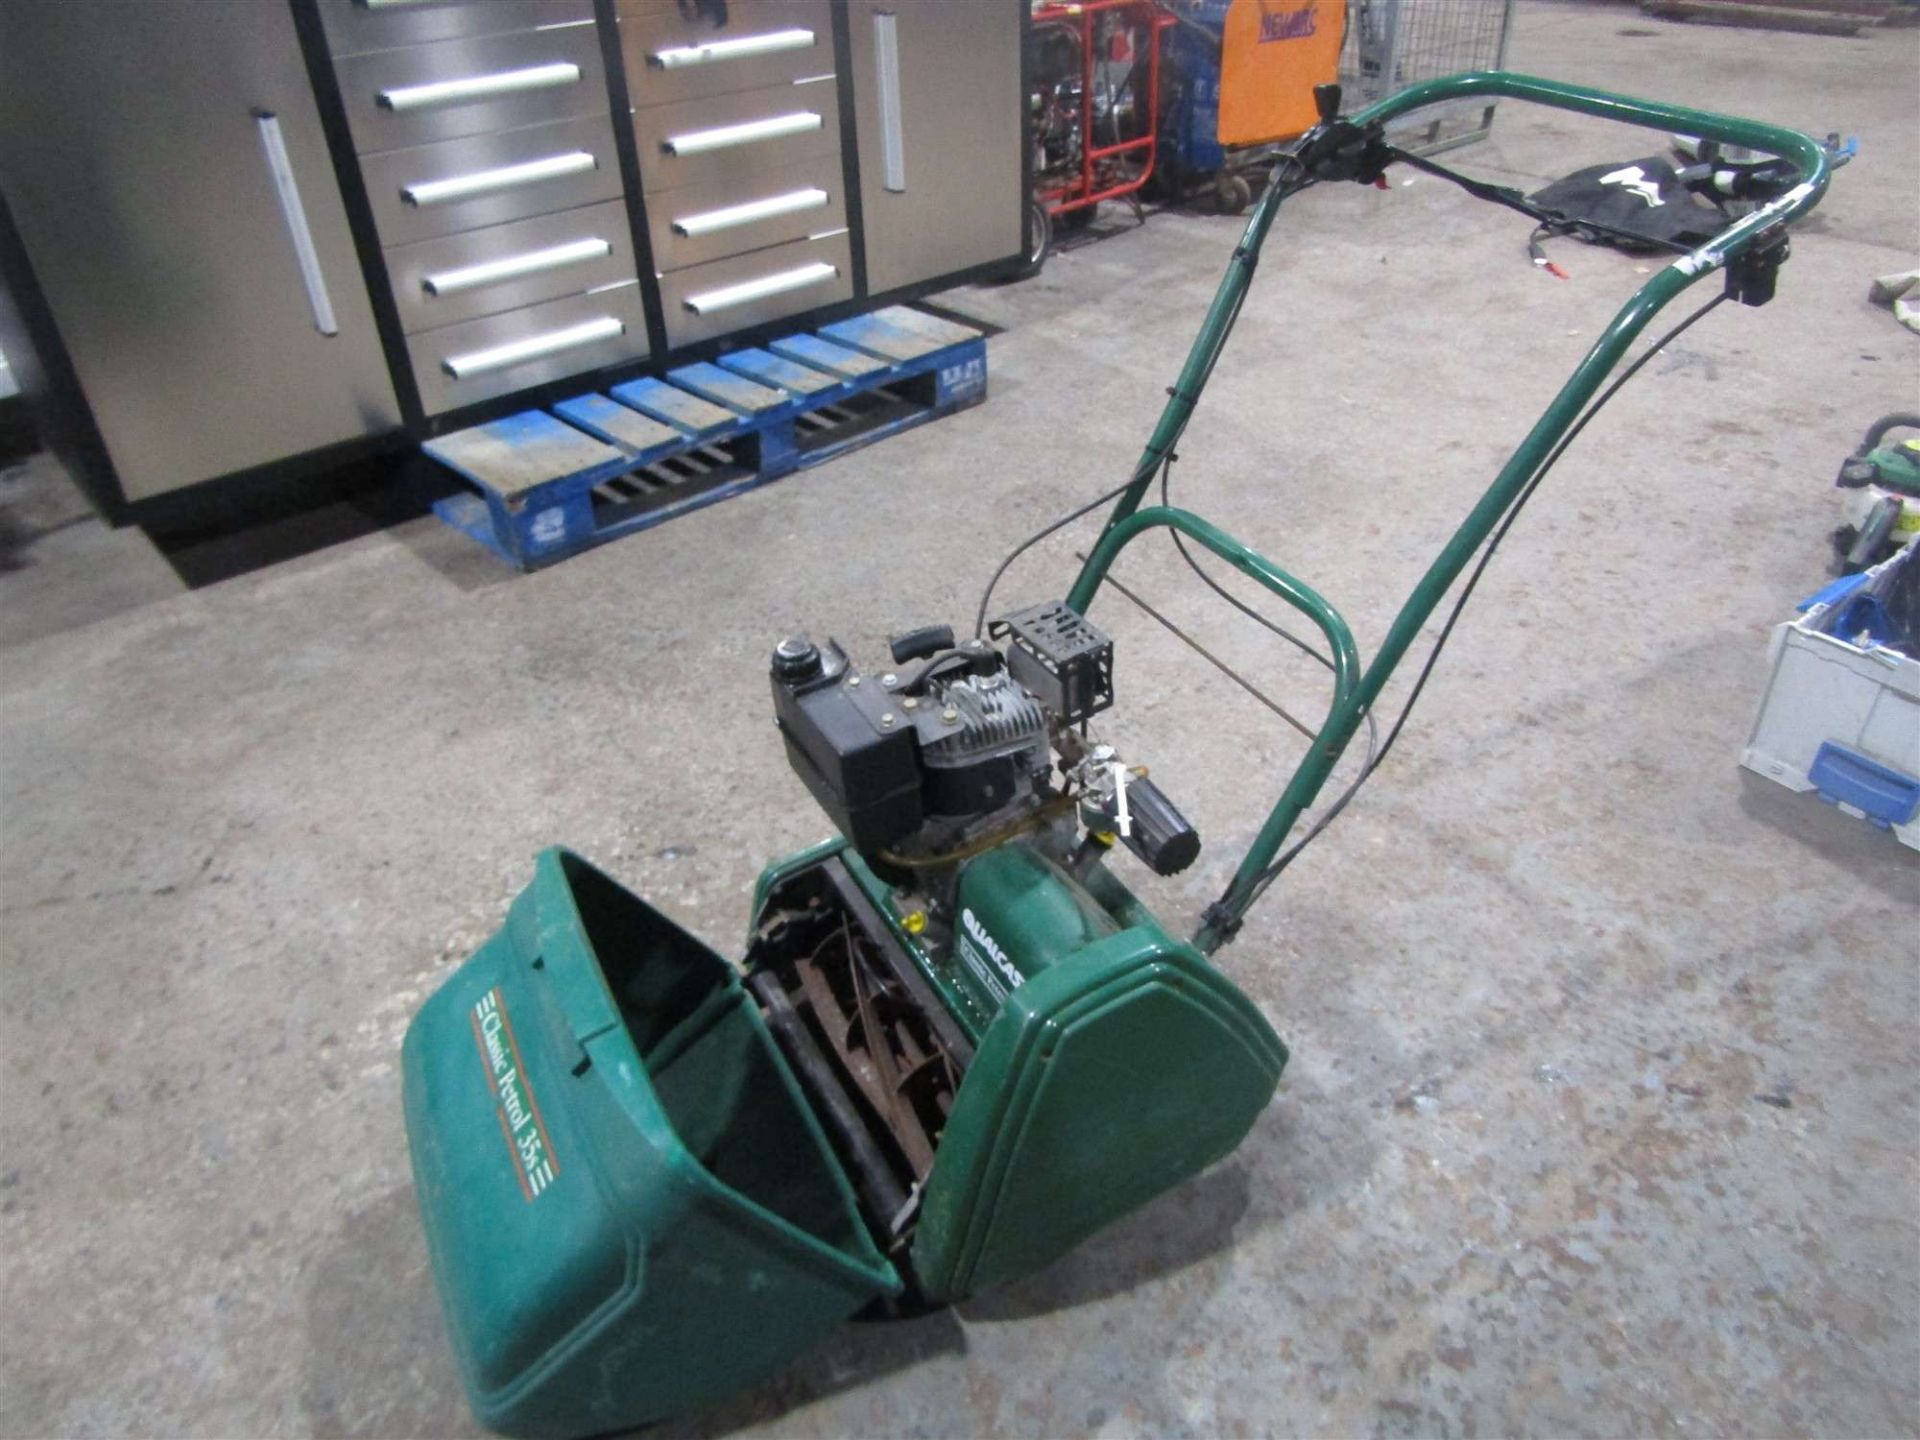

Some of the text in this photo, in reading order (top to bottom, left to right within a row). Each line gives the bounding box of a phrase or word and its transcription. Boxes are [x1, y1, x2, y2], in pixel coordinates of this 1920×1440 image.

[962, 908, 1026, 988] QUALCAS
[481, 1010, 542, 1171] Classic Petrol 35s
